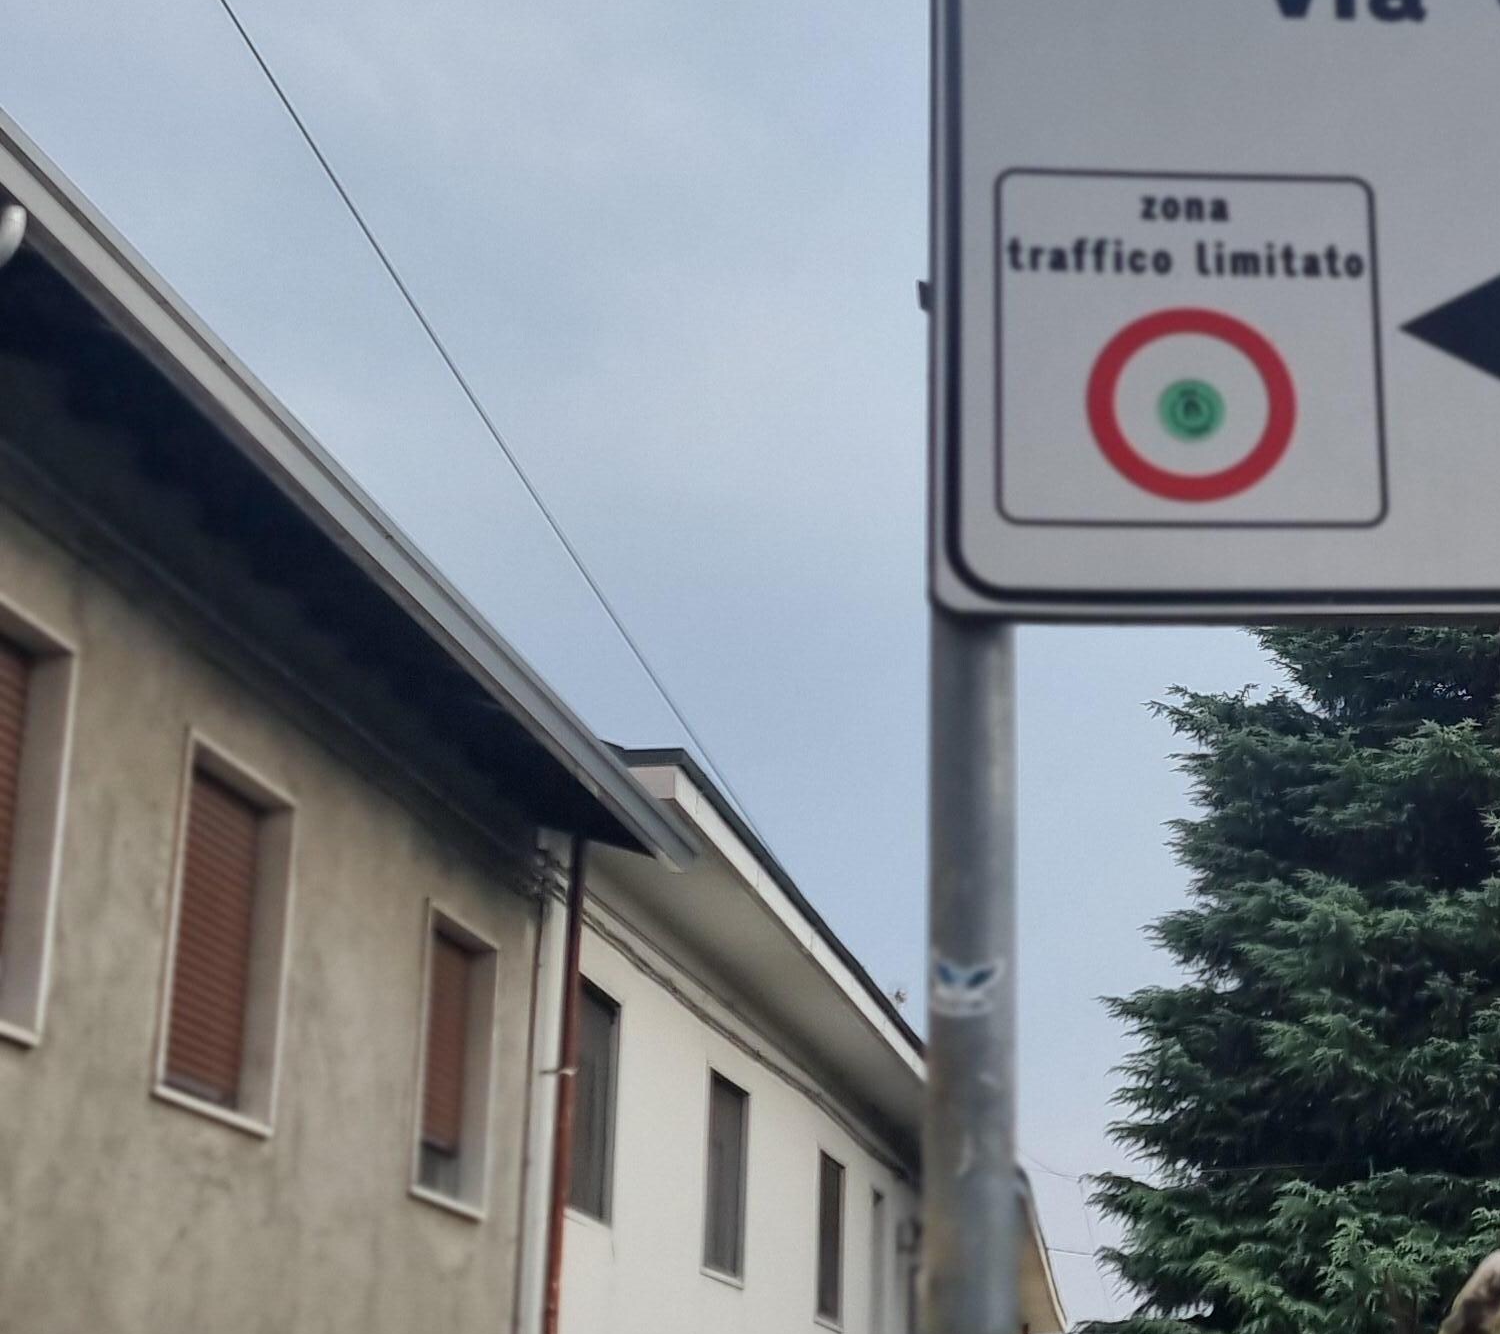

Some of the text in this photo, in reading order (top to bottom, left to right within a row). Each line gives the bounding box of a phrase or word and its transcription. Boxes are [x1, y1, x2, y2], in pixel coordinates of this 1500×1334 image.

[1140, 196, 1230, 223] zona
[1006, 237, 1365, 279] traffico limitato
